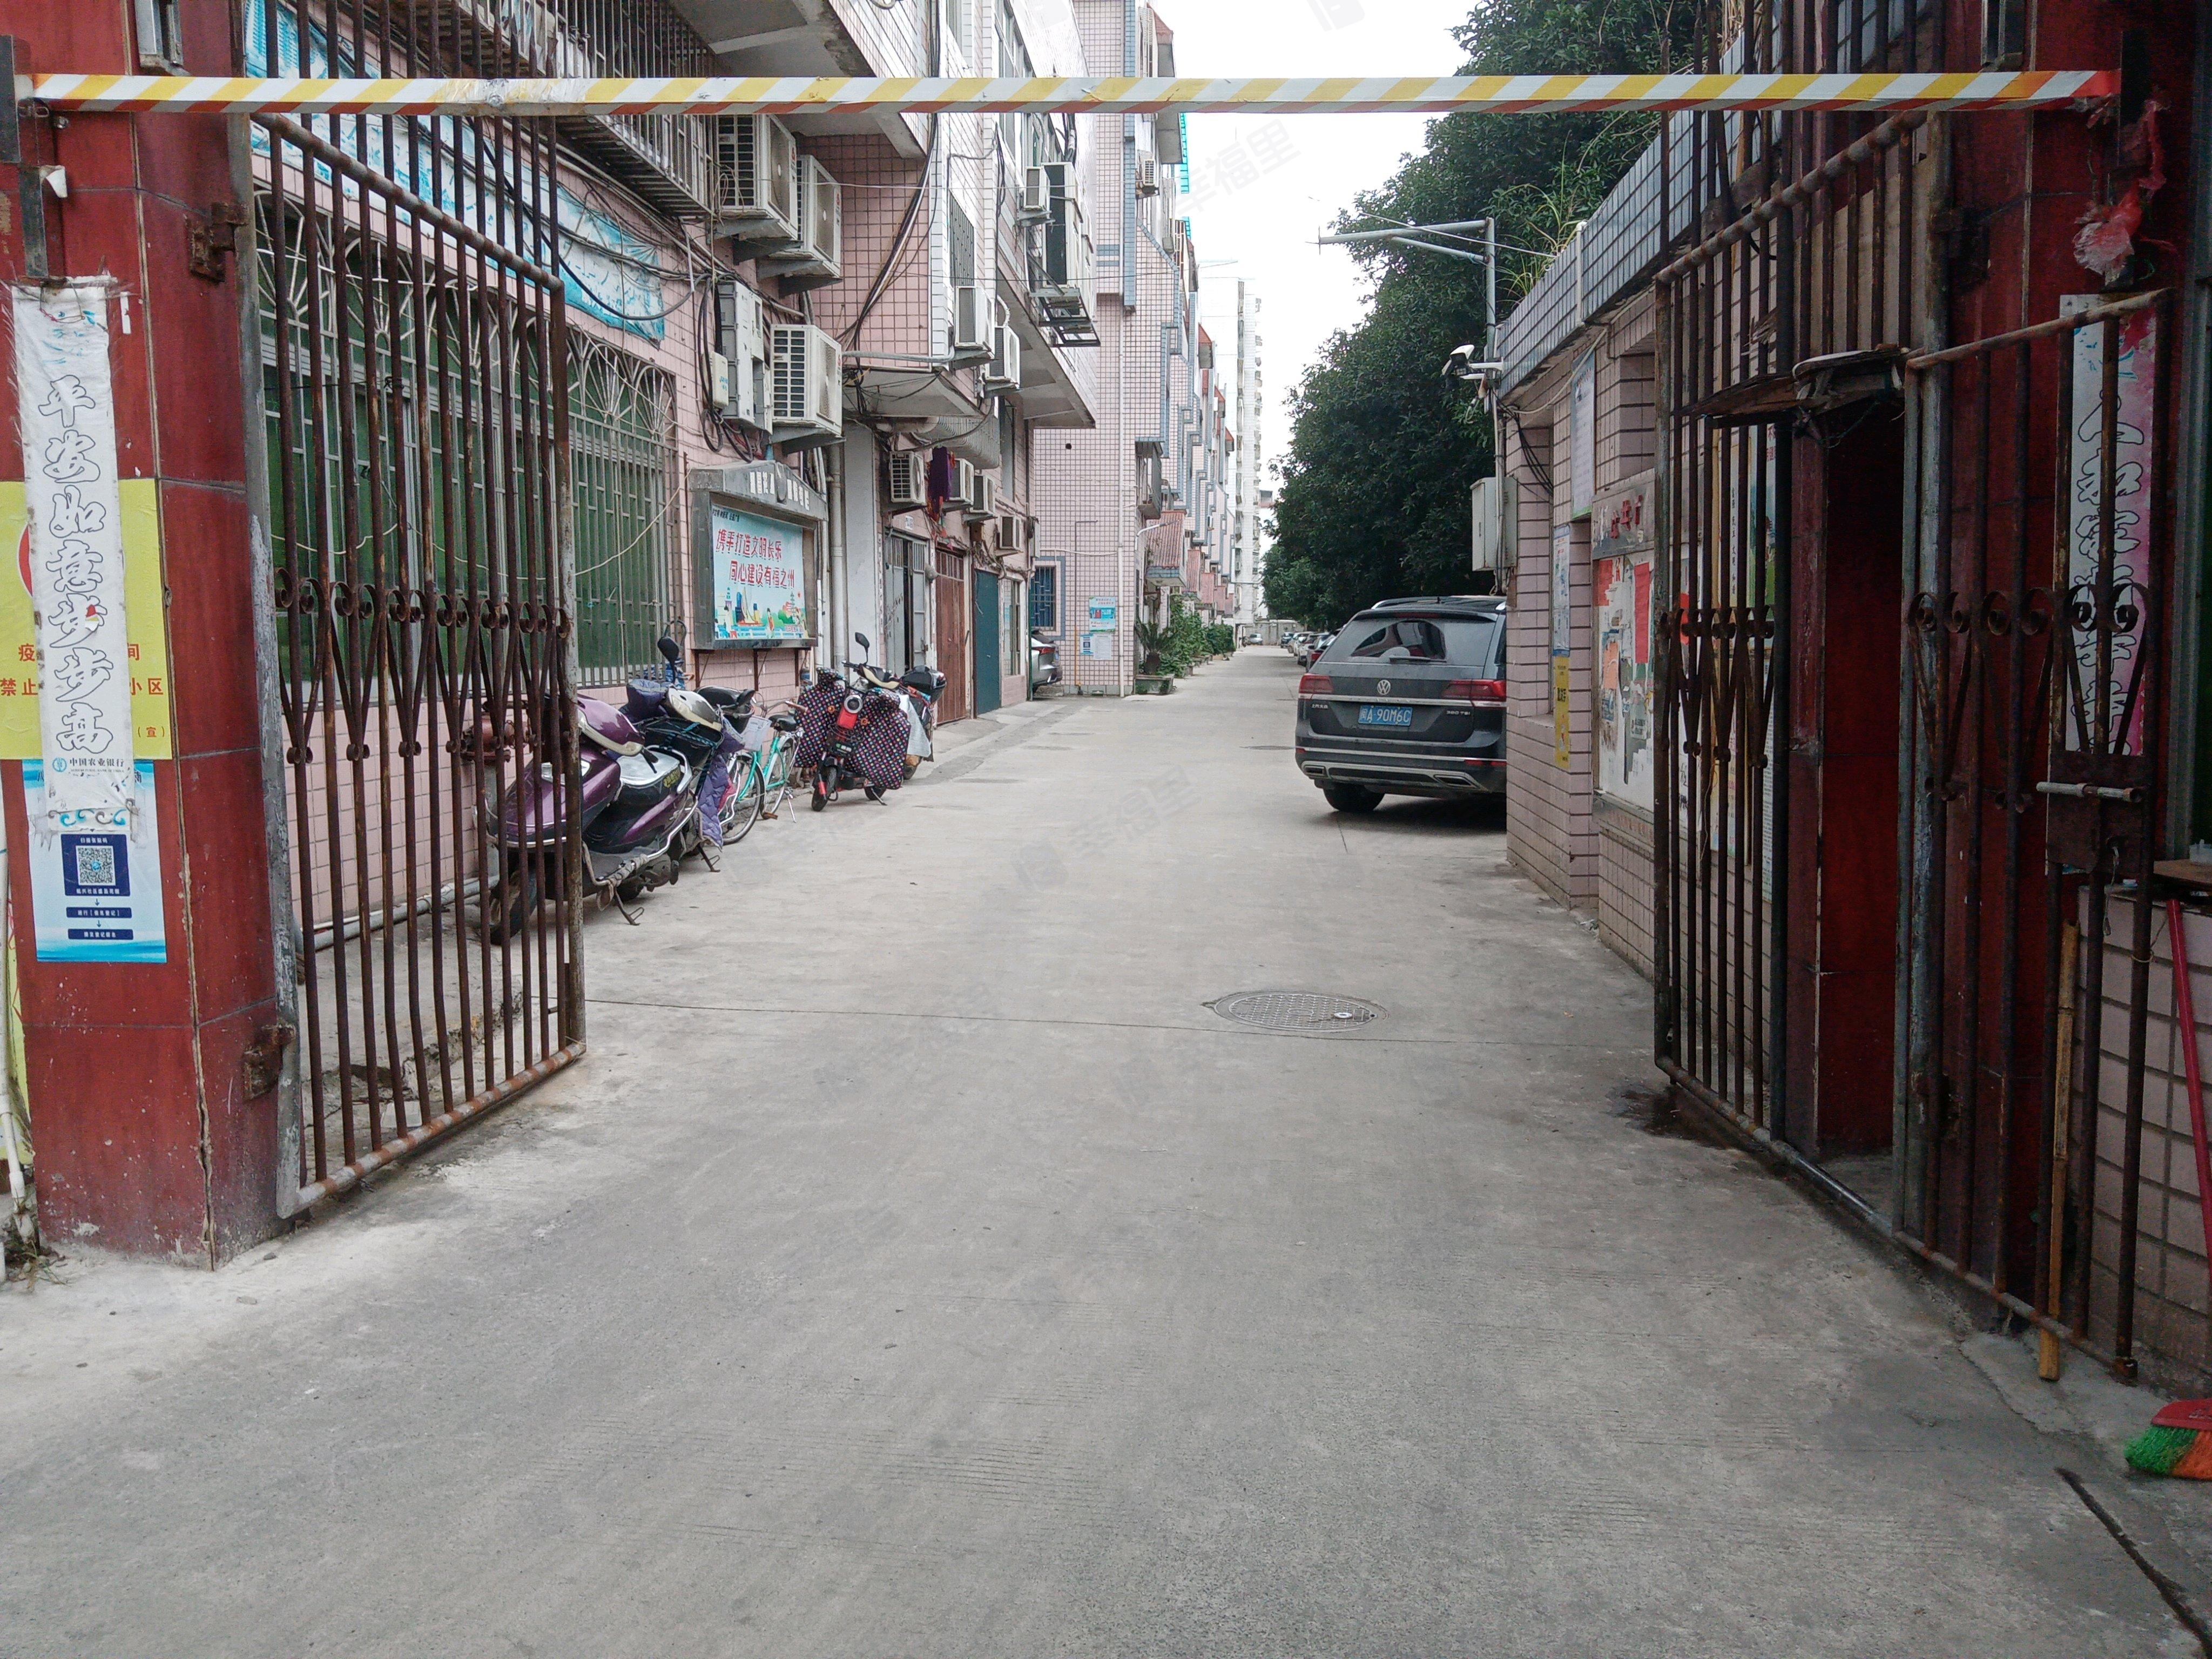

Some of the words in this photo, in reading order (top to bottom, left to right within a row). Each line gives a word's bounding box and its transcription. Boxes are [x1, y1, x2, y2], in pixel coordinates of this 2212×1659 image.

[716, 529, 782, 560] 携手打造文明长乐
[730, 560, 794, 588] 同心建设有福之州
[69, 757, 124, 767] 中国农业银行
